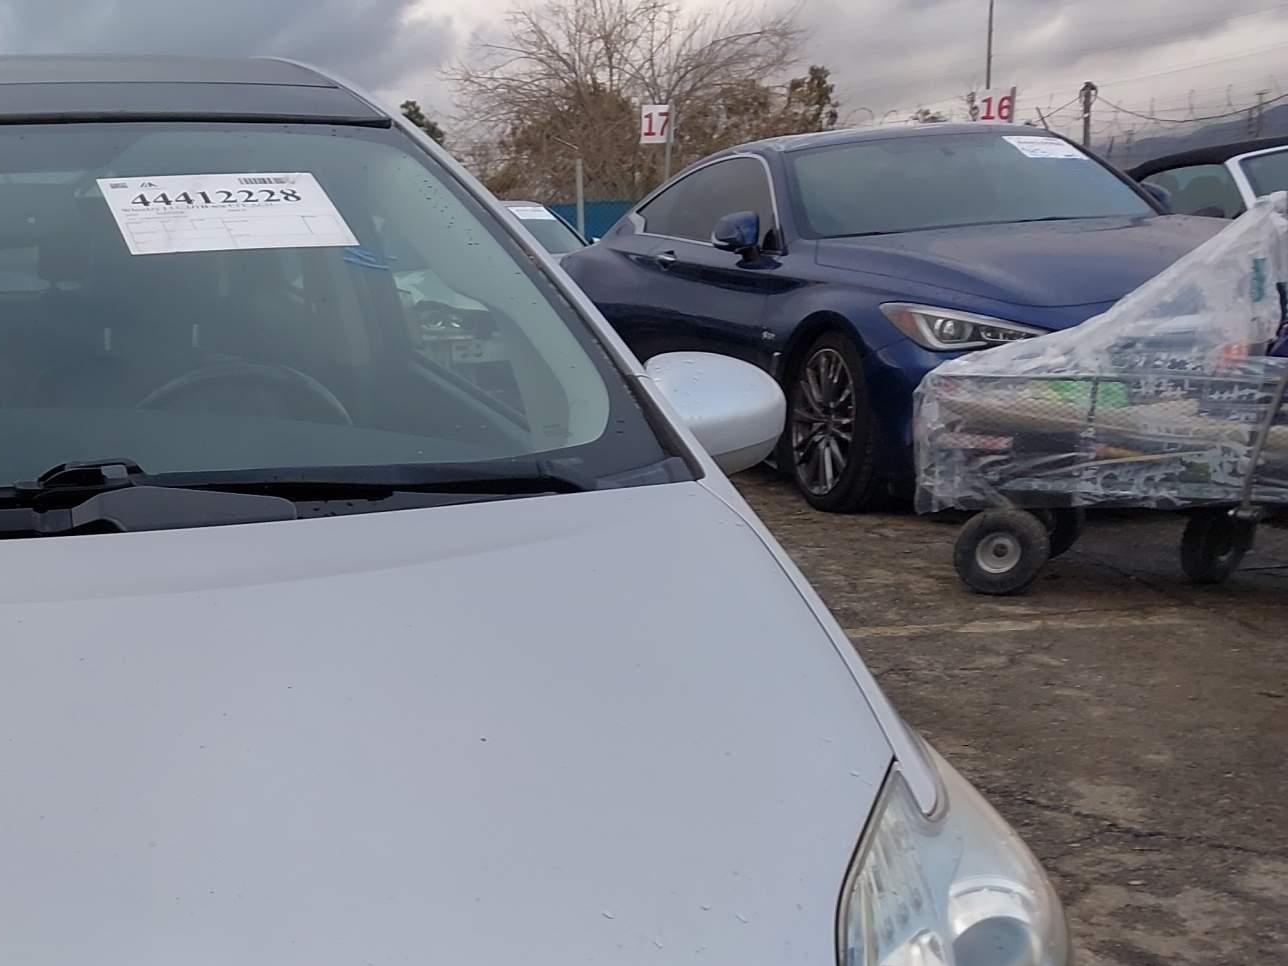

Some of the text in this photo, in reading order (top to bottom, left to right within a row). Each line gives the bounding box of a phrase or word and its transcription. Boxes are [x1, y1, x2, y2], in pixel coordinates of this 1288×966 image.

[980, 95, 1012, 120] 16
[643, 111, 671, 137] 17
[130, 187, 302, 207] 44412228
